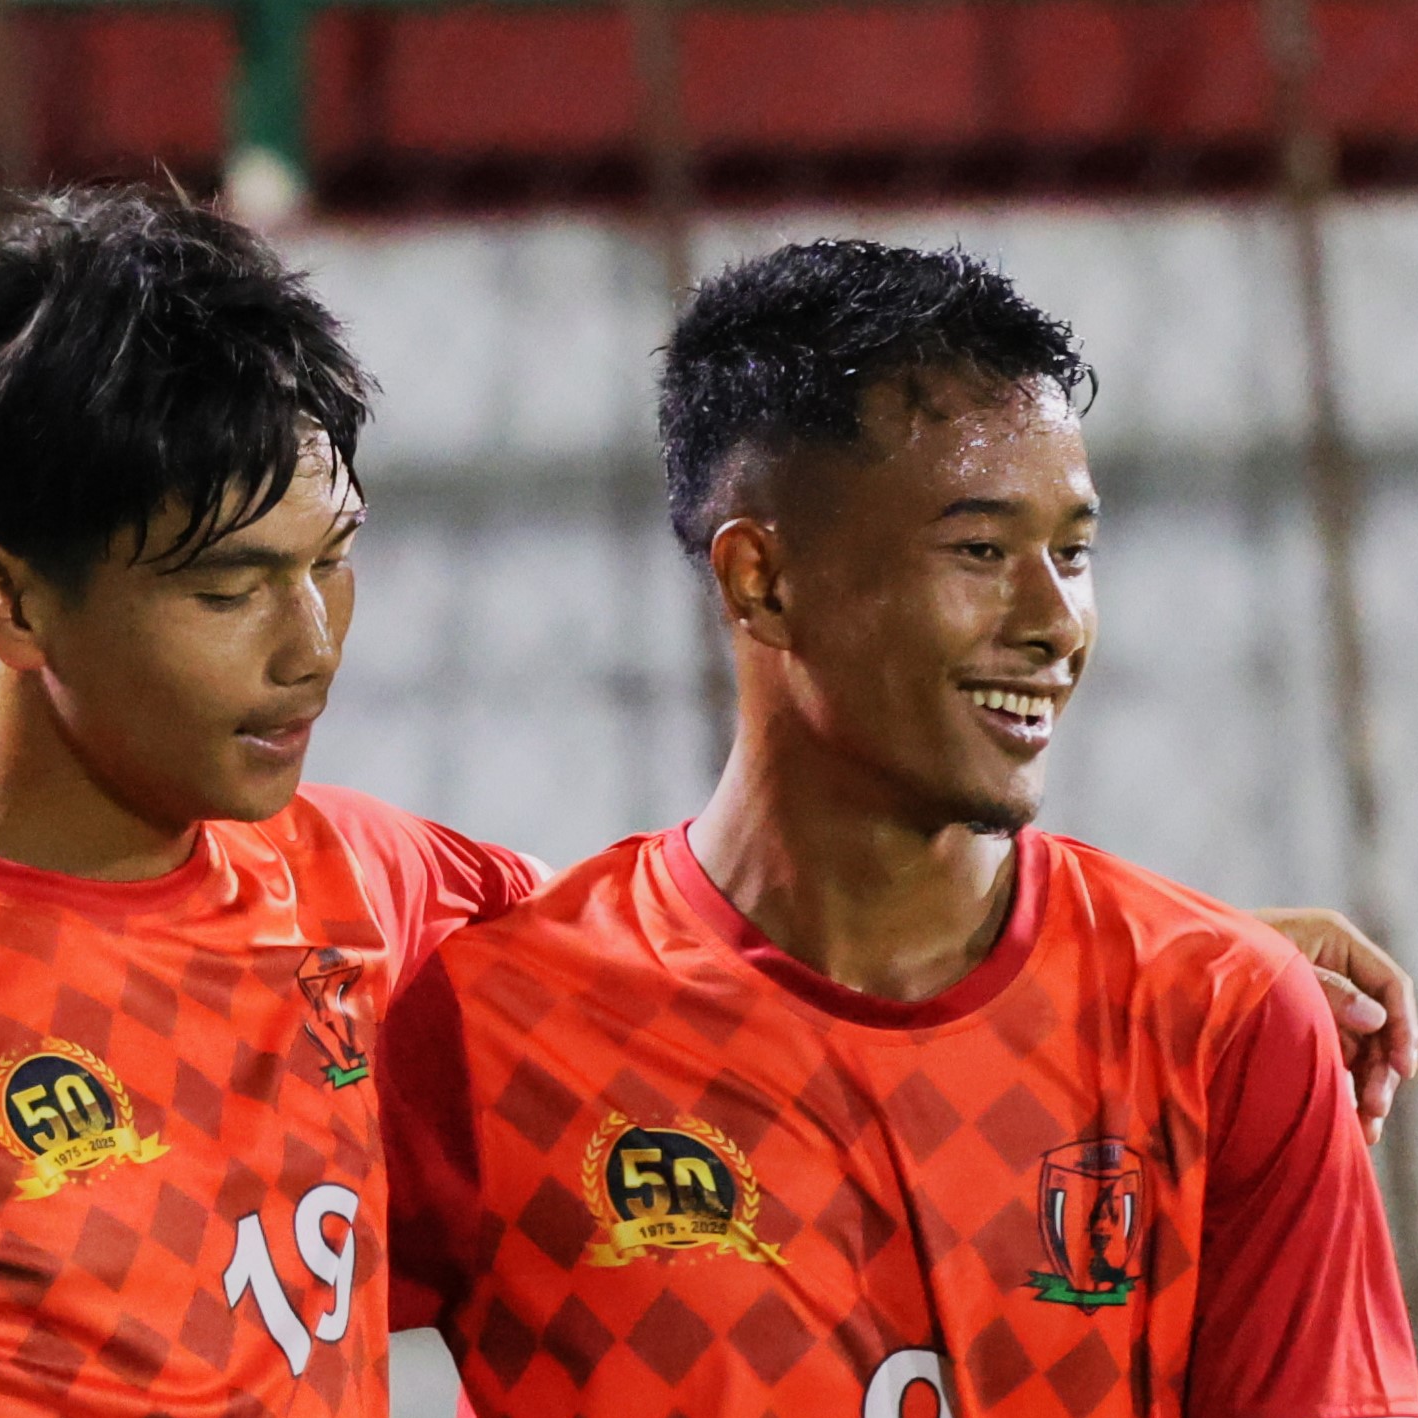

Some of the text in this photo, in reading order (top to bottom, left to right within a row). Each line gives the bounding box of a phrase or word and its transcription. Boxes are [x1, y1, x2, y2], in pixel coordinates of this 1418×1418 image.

[11, 1074, 106, 1150] 50
[54, 1146, 81, 1166] 1975
[89, 1137, 116, 1151] 2025
[620, 1148, 722, 1216] 50
[222, 1182, 358, 1378] 19
